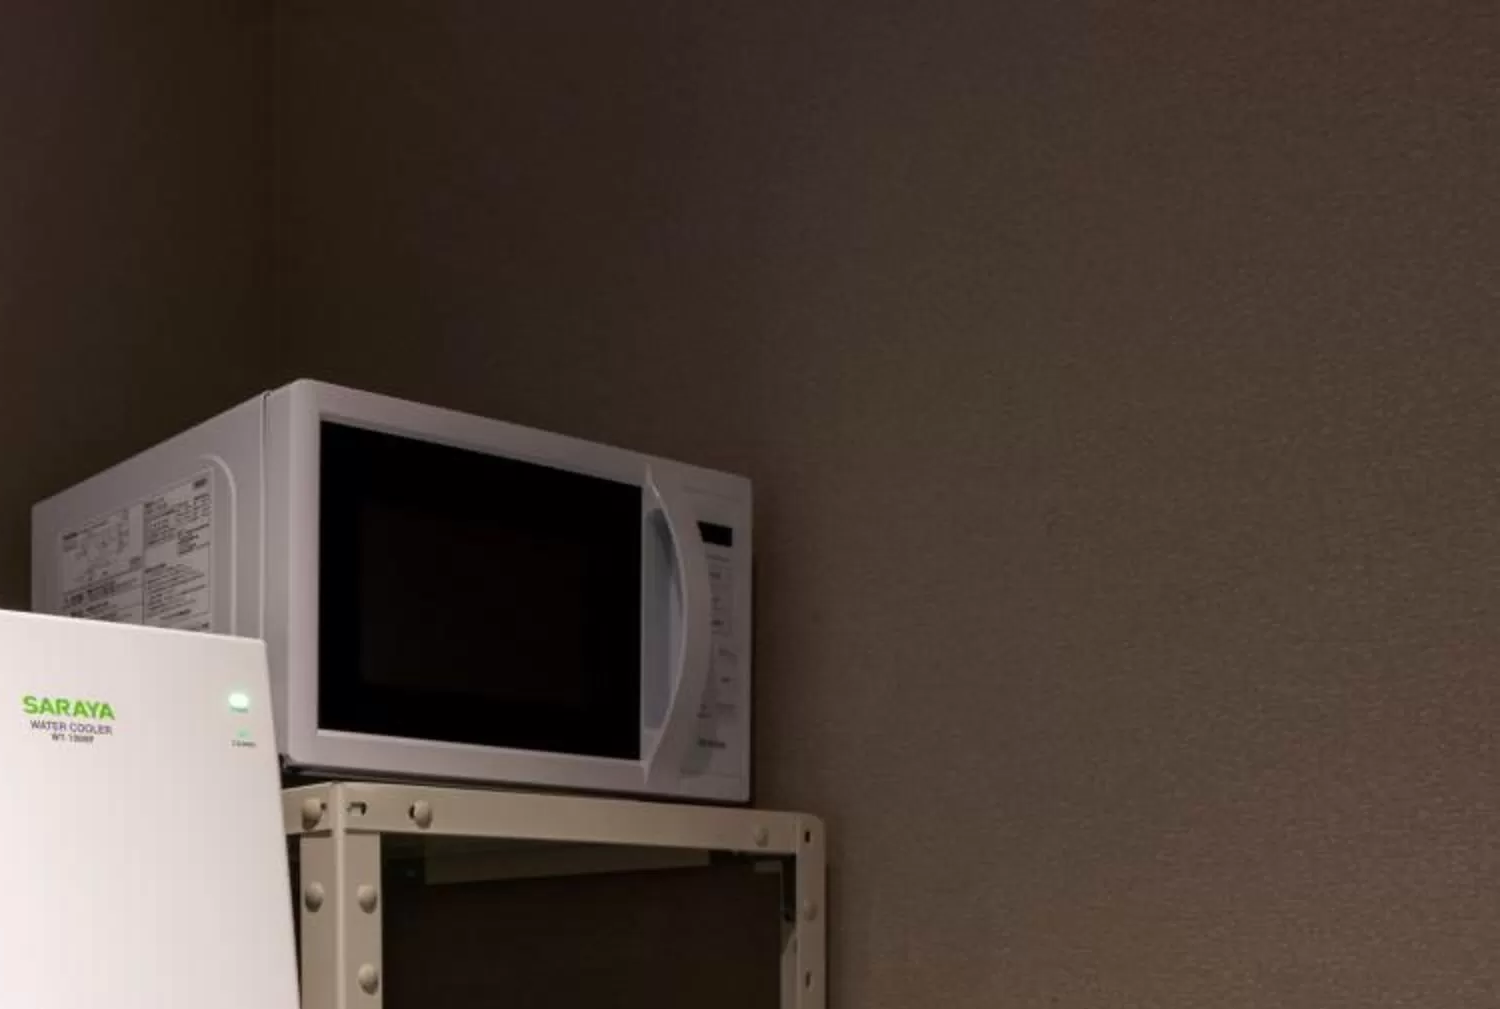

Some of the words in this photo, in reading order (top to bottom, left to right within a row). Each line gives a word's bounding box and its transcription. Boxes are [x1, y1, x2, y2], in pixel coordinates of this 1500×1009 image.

[22, 694, 116, 720] SARAYA
[30, 719, 67, 732] WATER
[69, 723, 113, 735] COOLER
